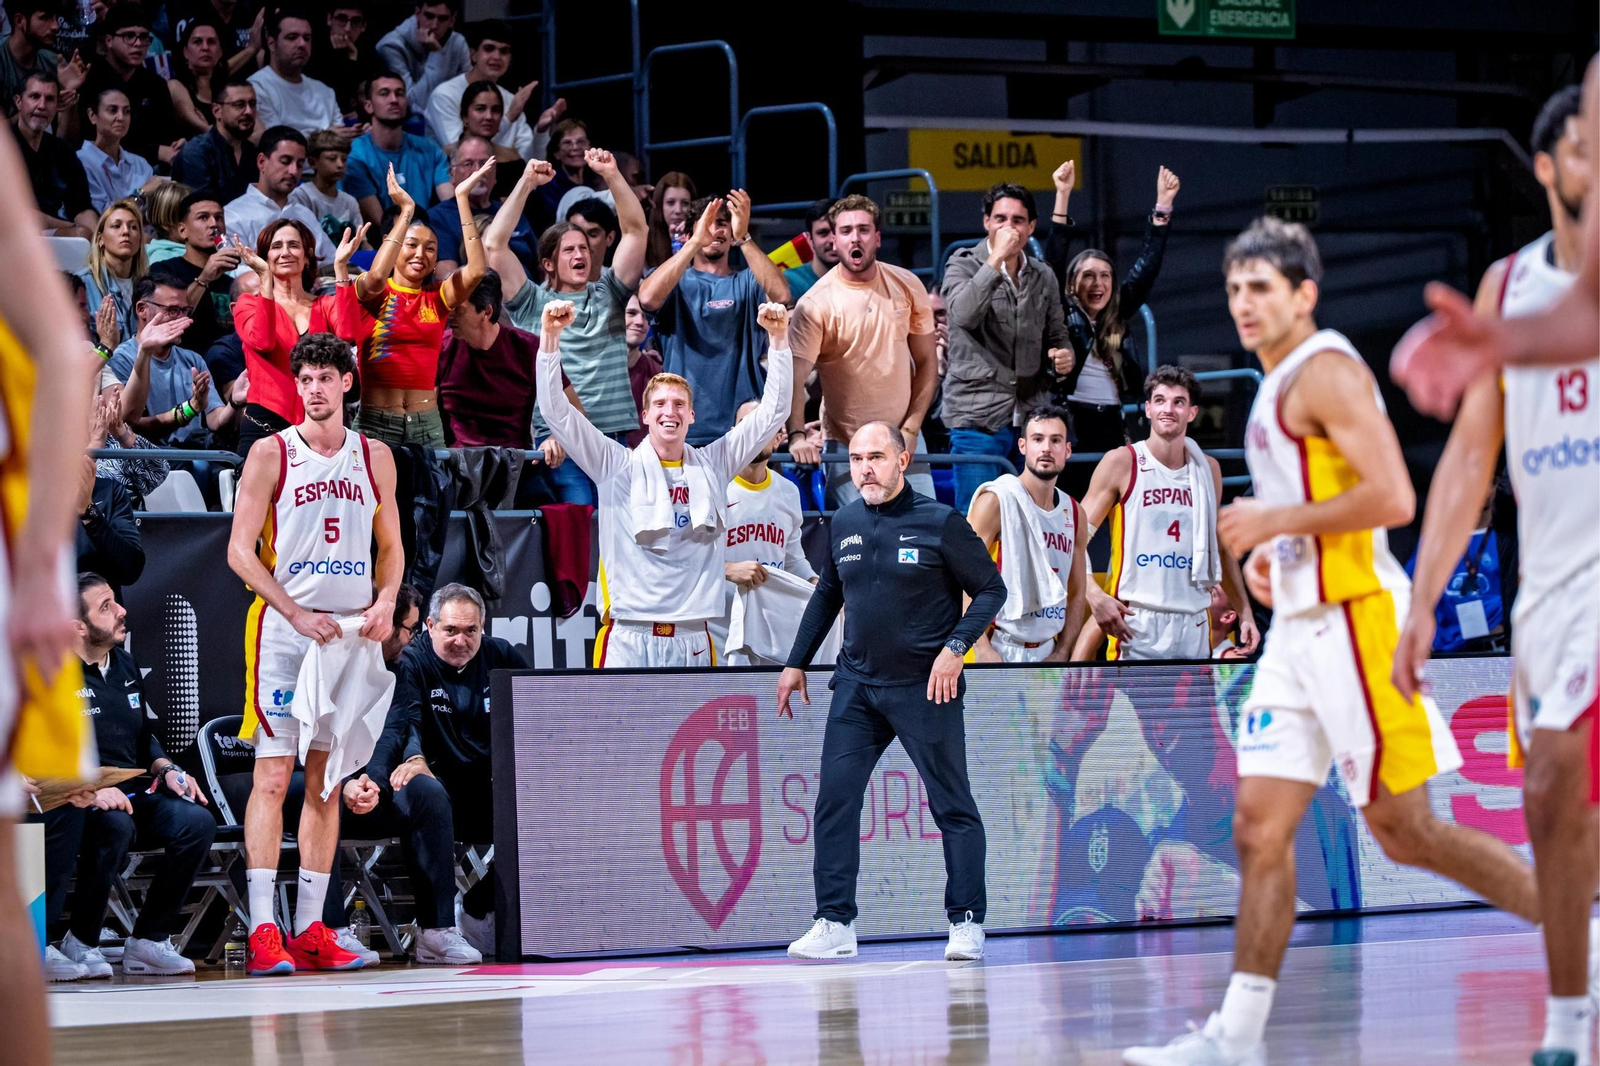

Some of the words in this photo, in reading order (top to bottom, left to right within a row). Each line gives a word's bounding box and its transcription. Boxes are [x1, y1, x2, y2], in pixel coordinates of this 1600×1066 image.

[1209, 9, 1290, 27] EMERGENCIA
[954, 142, 1038, 169] SALIDA
[1557, 367, 1589, 414] 13
[294, 477, 365, 508] ESPAÑA
[324, 518, 340, 544] 5
[727, 522, 785, 548] ESPAÑA
[840, 533, 863, 551] ESPAÑA
[1167, 519, 1181, 543] 4
[288, 556, 366, 576] endesa
[839, 553, 861, 563] endesa
[265, 707, 293, 718] tenerife
[716, 708, 750, 731] FEB
